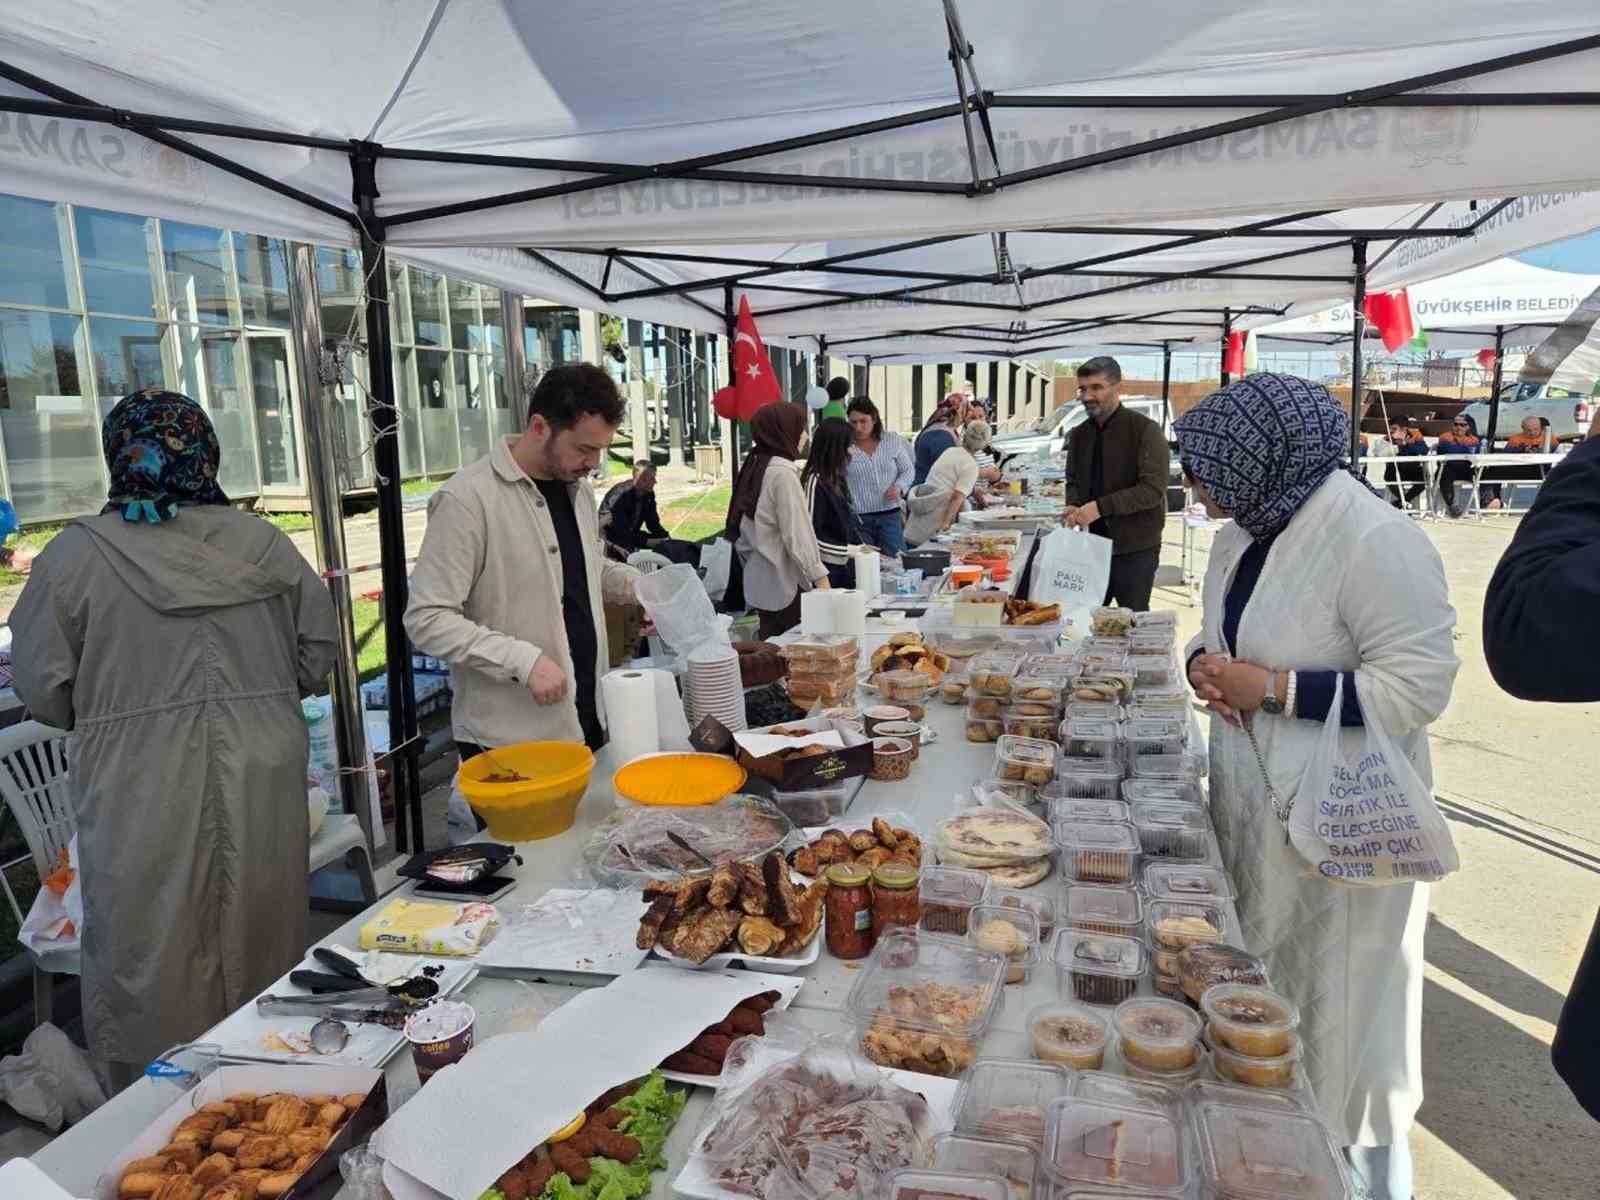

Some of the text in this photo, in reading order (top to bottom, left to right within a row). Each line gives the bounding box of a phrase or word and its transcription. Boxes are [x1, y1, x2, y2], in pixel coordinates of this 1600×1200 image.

[1417, 297, 1512, 315] ÜYÜKŞEHİR
[1054, 580, 1086, 592] MARK
[1057, 571, 1084, 584] PAUL
[1318, 814, 1421, 839] GELECEĞİNE
[1328, 840, 1382, 857] SAHİP
